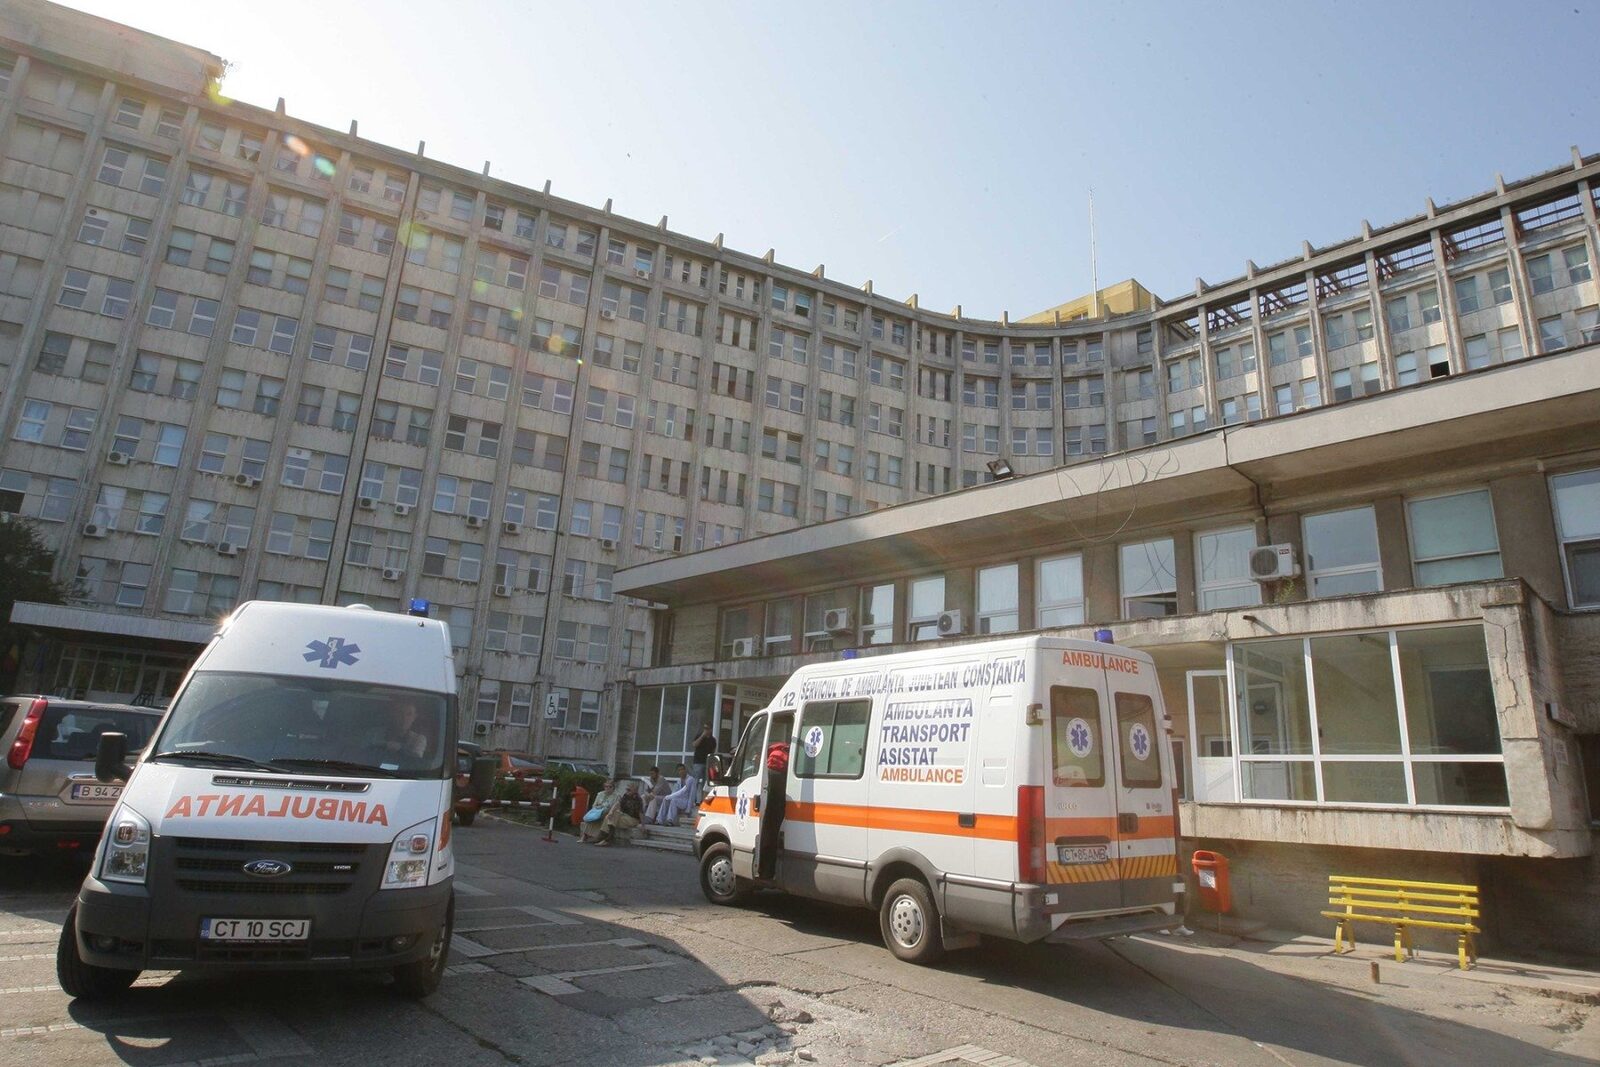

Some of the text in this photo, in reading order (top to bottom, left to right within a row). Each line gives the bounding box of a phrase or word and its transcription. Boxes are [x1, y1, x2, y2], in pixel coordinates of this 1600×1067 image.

[1062, 651, 1139, 675] AMBULANCE
[800, 680, 837, 700] SERVICIUL
[840, 677, 853, 697] DE
[962, 659, 1026, 688] CONSTANTA
[885, 700, 973, 721] AMBULANTA
[882, 723, 971, 743] TRANSPORT
[879, 747, 938, 766] ASISTAT
[881, 768, 963, 783] AMBULANCE
[81, 786, 90, 796] B
[94, 786, 108, 796] 94
[255, 862, 280, 874] Ford
[214, 921, 306, 938] CT 10 SCJ
